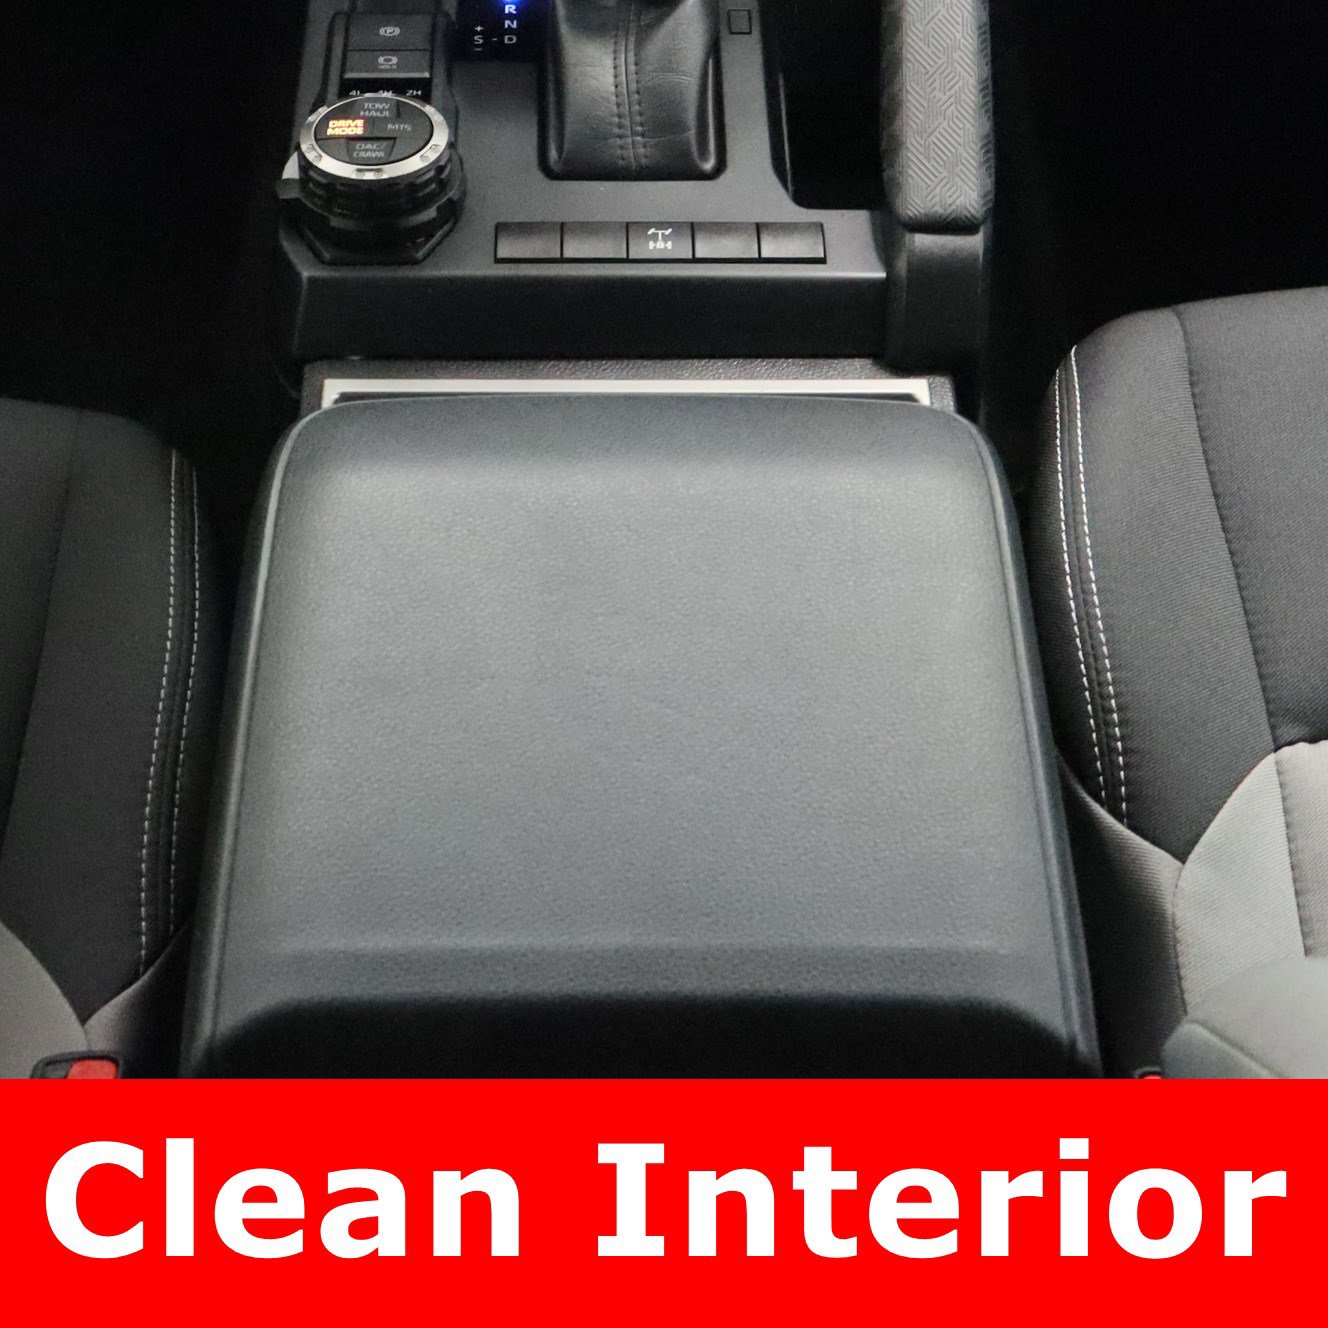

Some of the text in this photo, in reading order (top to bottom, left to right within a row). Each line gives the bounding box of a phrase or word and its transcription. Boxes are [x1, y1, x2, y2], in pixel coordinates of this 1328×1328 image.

[504, 4, 517, 14] R
[504, 20, 517, 29] N
[474, 34, 517, 44] S D
[360, 110, 390, 118] HAUL
[328, 119, 365, 127] DRIVE
[387, 123, 412, 132] MTS
[327, 128, 364, 136] MODE
